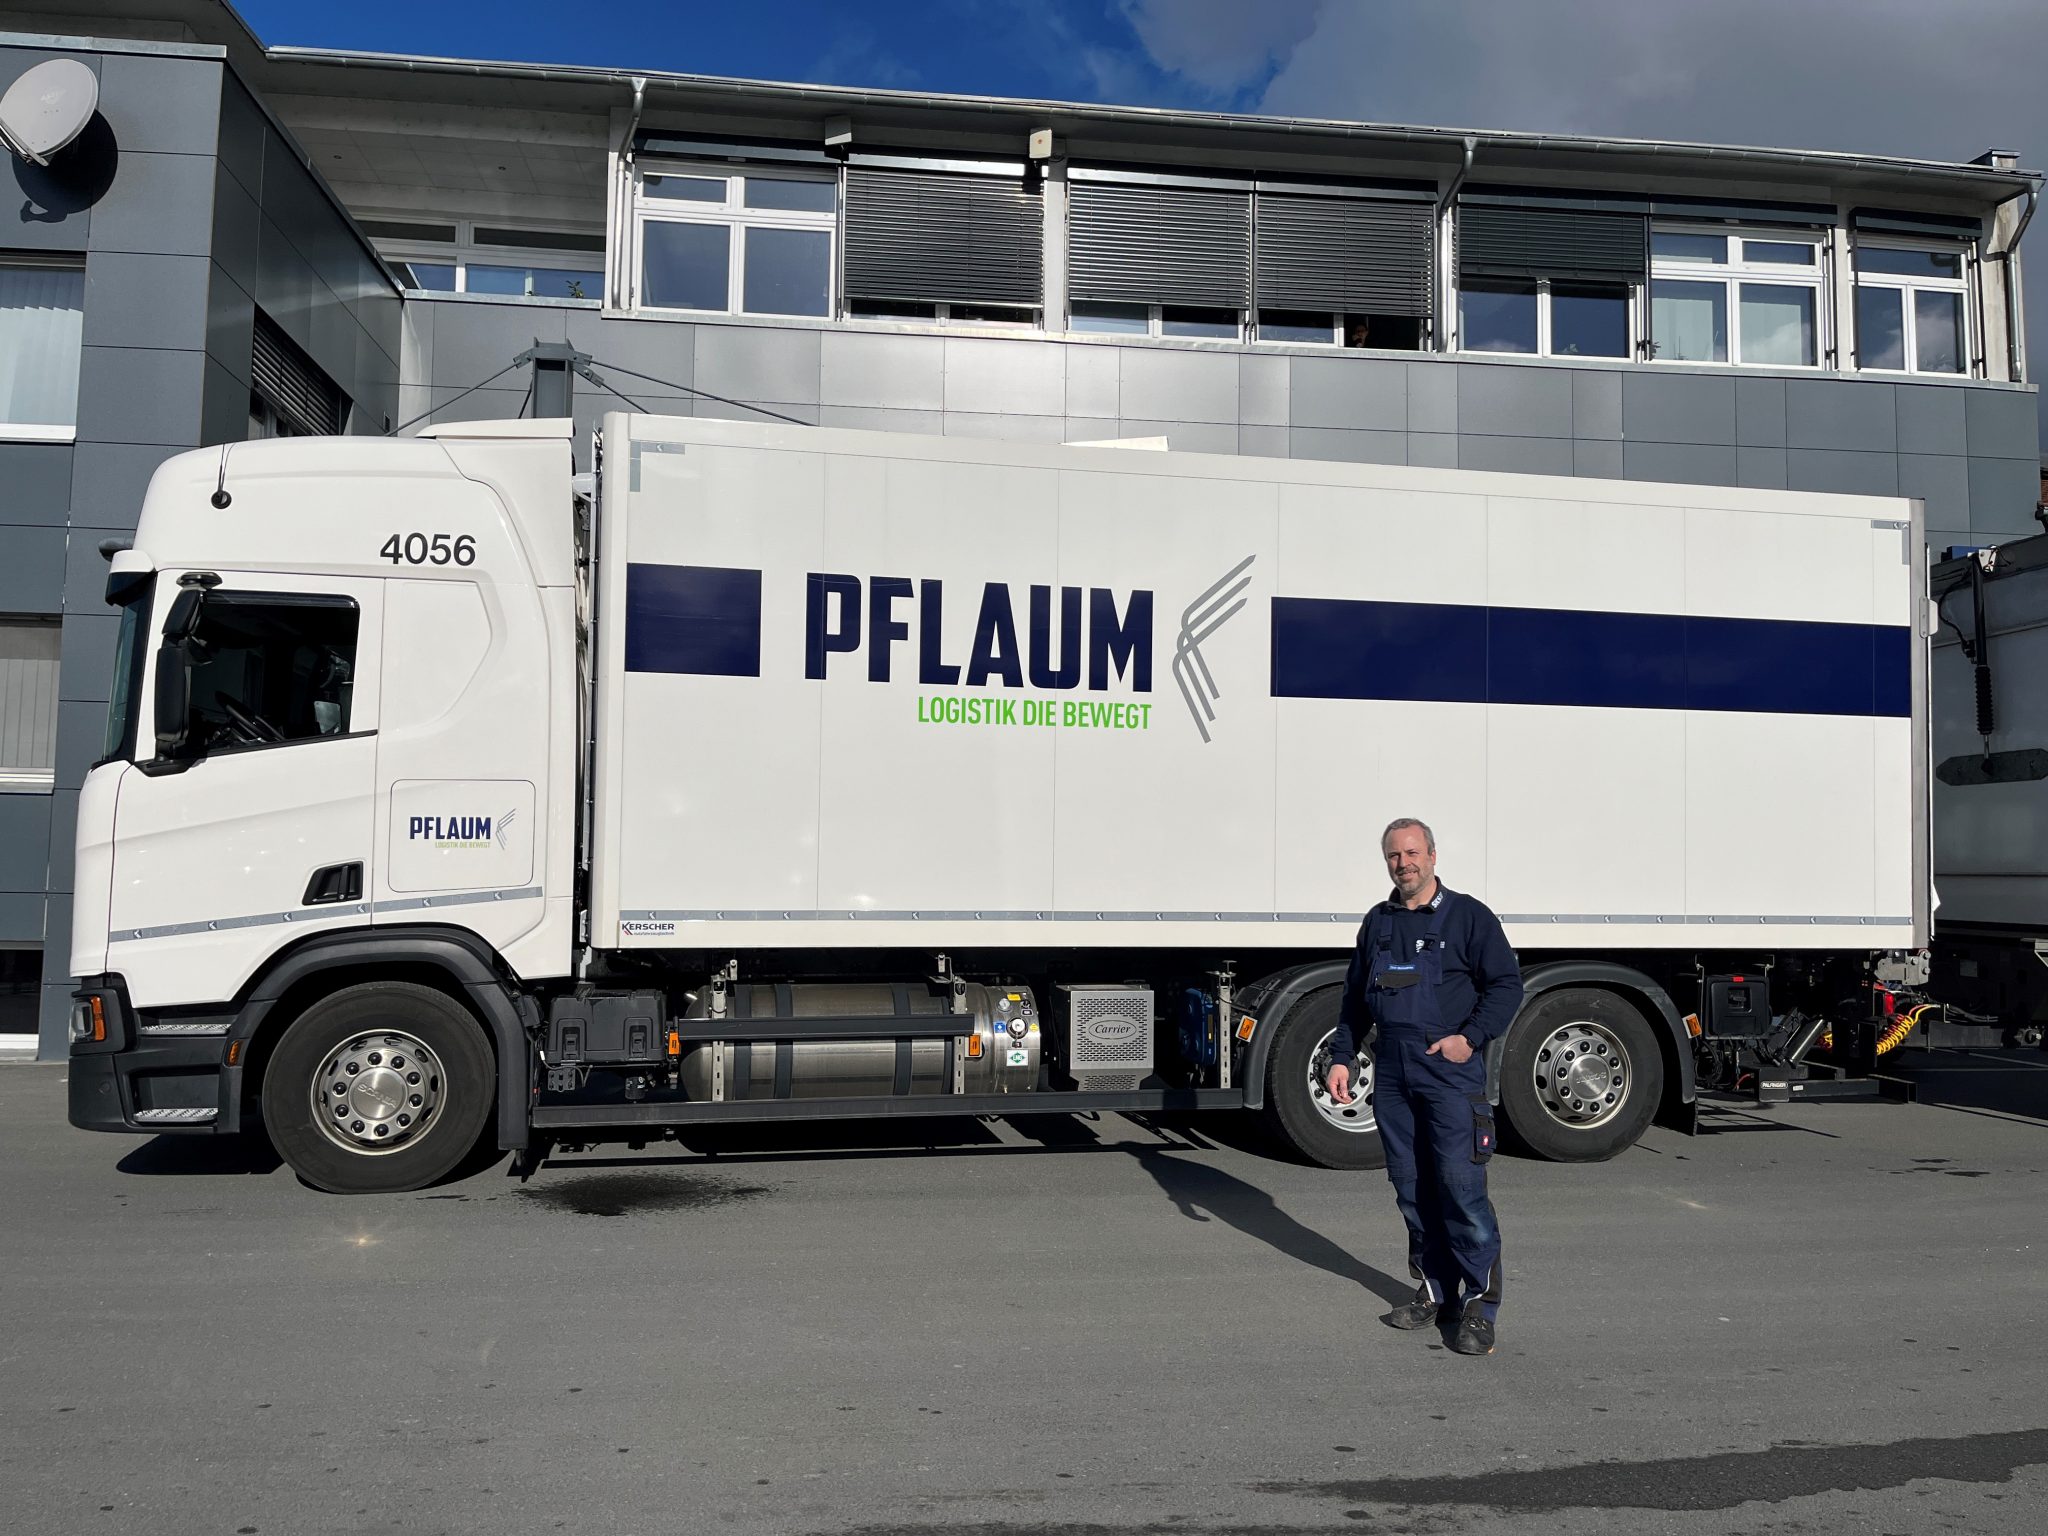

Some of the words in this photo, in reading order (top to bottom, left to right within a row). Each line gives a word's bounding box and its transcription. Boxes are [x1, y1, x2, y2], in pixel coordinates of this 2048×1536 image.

[379, 532, 477, 566] 4056
[805, 573, 1153, 692] PFLAUM
[918, 697, 1016, 726] LOGISTIK
[1023, 700, 1057, 726] DIE
[1063, 702, 1152, 730] BEWEGT
[409, 816, 491, 839] PFLAUM
[622, 922, 674, 935] KERSCHER
[1095, 1024, 1131, 1034] Carrier
